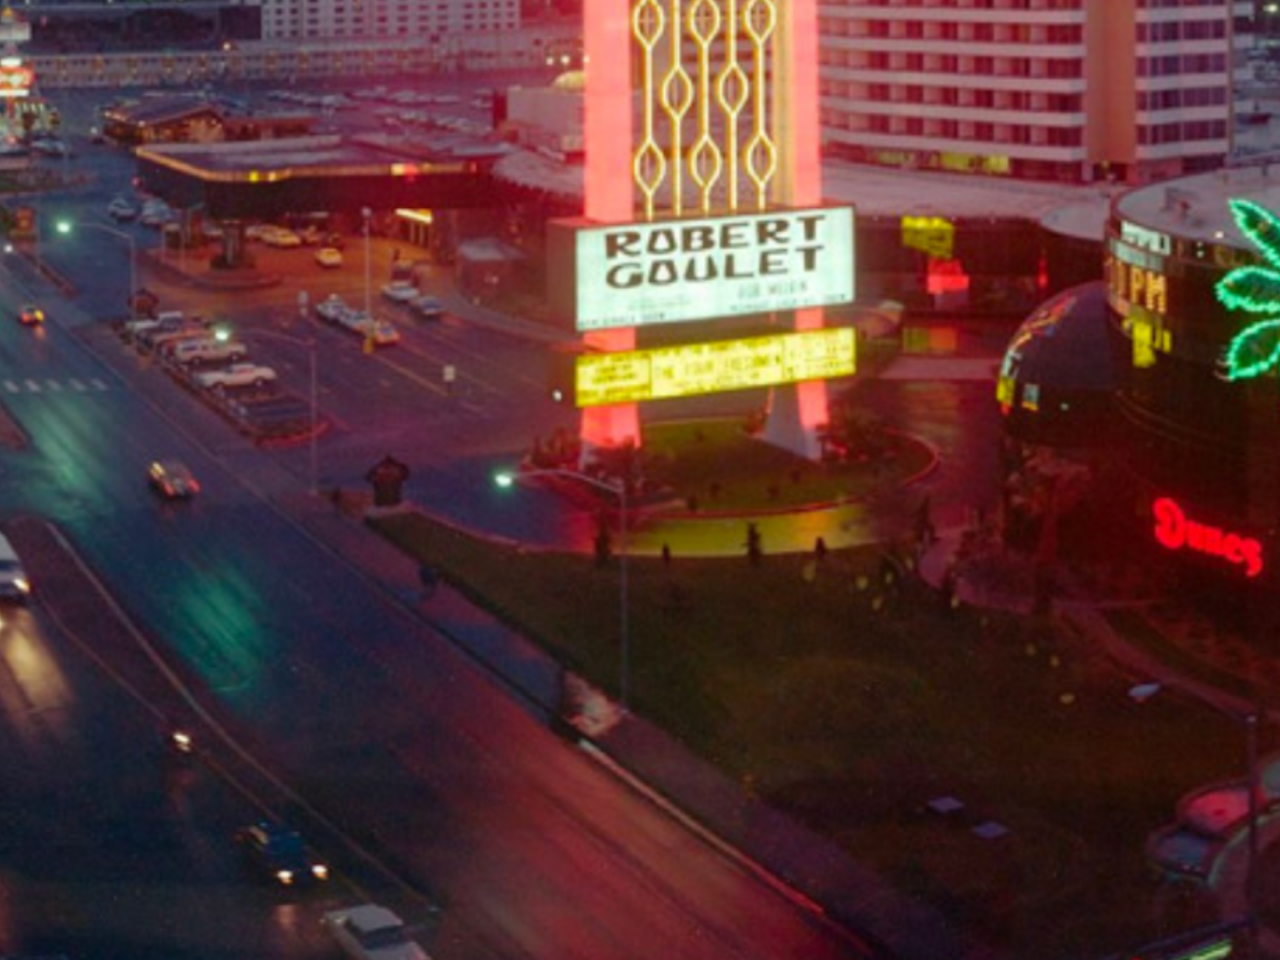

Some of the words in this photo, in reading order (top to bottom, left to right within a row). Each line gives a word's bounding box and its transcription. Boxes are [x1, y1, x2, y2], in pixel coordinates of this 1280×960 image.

[605, 214, 826, 259] ROBERT
[605, 245, 825, 289] GOULET
[1152, 496, 1263, 578] Dunes
